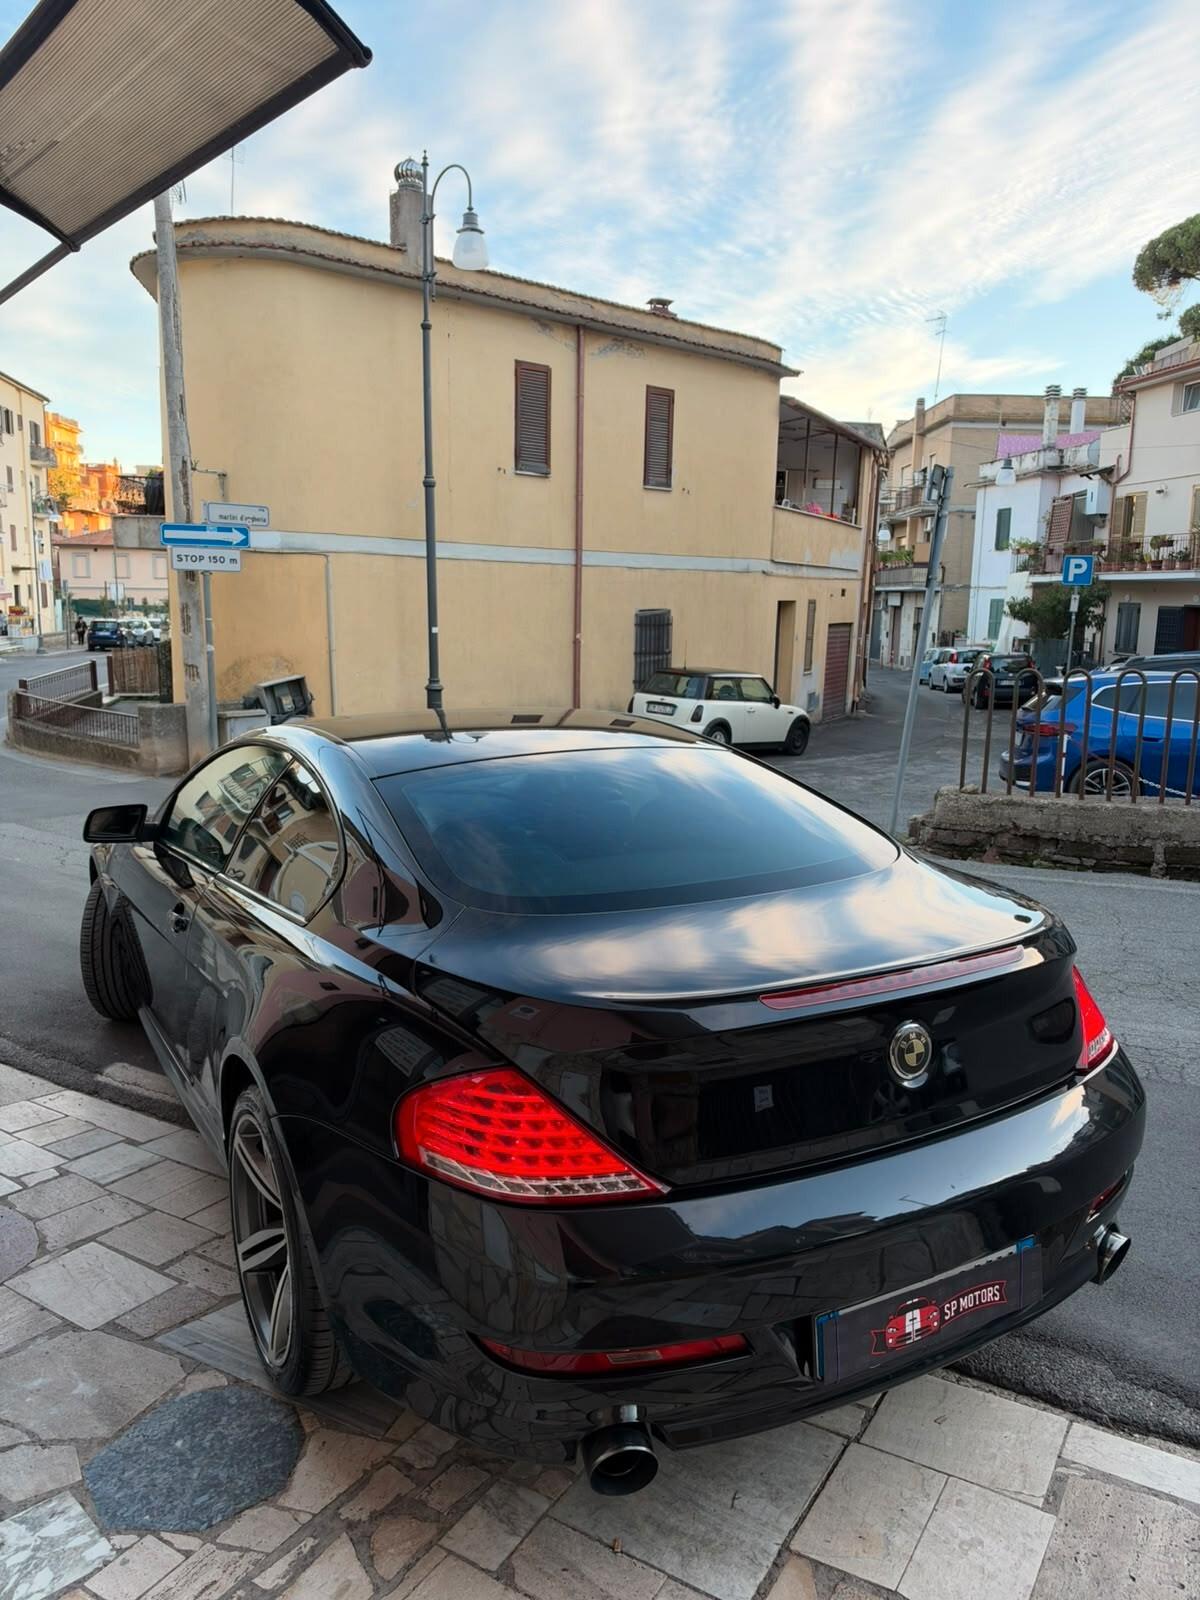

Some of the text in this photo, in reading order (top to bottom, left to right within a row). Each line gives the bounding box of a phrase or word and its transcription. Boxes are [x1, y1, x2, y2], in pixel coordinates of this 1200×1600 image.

[176, 553, 205, 563] STOP
[208, 555, 226, 564] 150
[1068, 558, 1088, 582] P
[944, 1285, 1000, 1320] SP MOTORS
